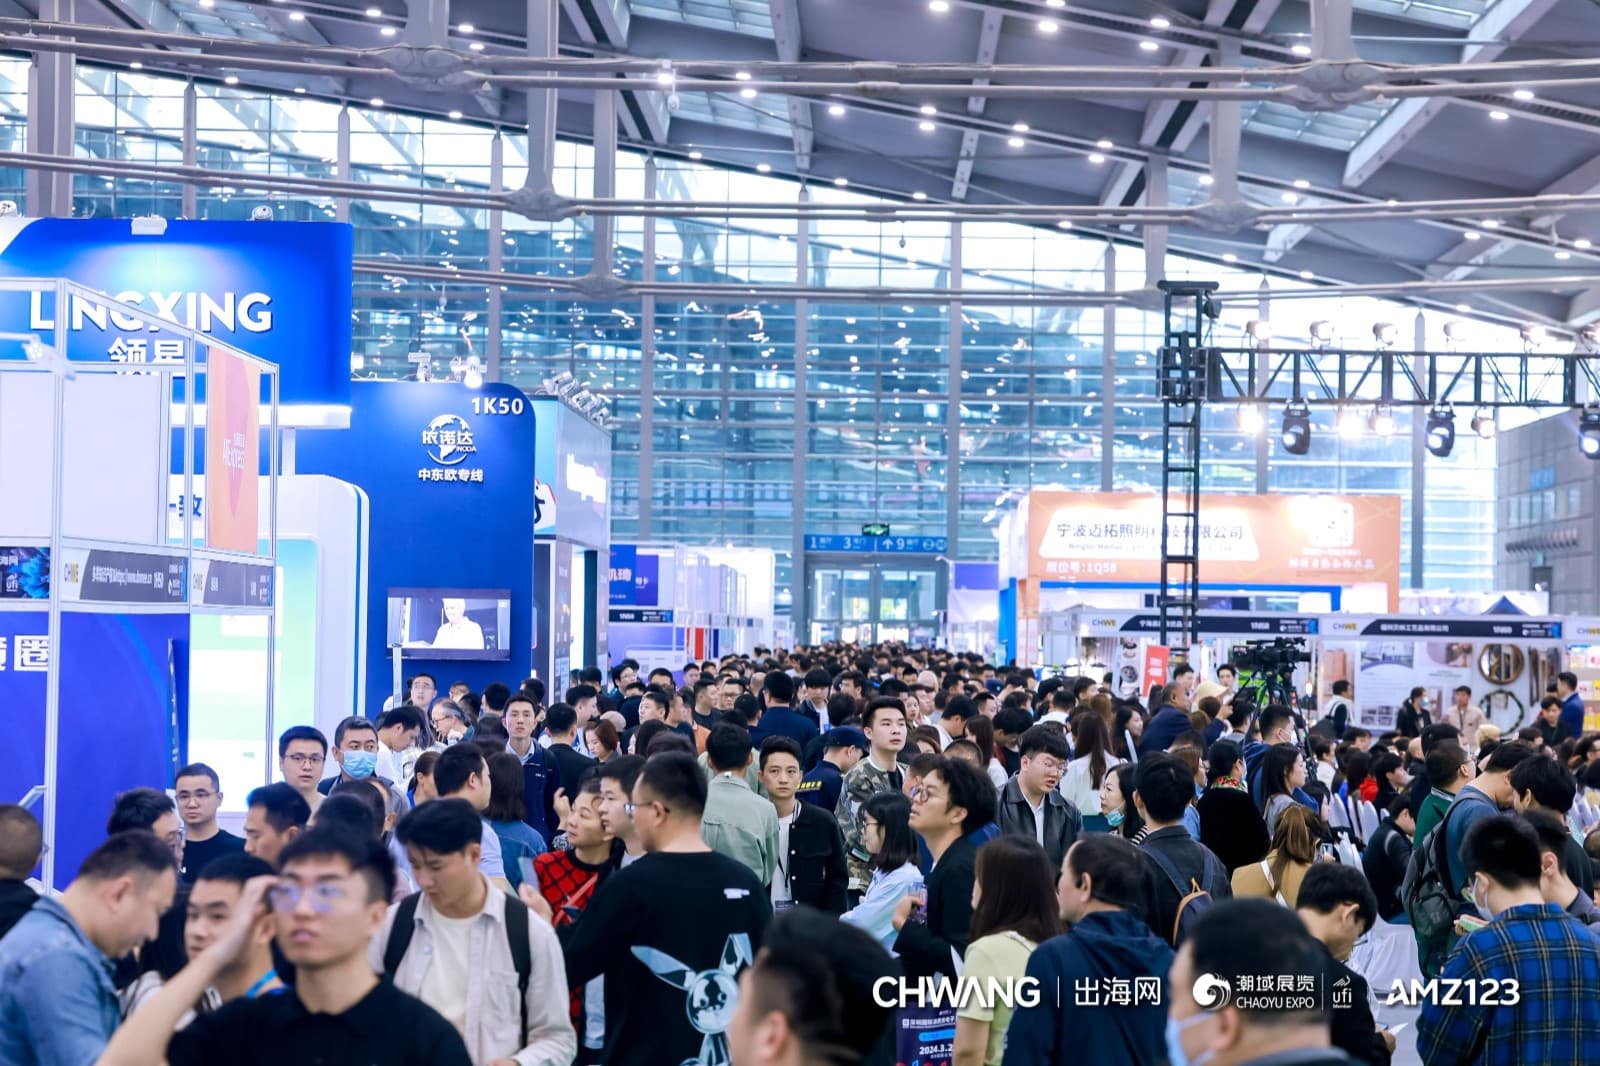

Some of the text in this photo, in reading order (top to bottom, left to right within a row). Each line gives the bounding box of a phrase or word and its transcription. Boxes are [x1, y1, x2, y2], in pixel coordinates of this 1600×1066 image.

[30, 291, 272, 332] LNGXING
[472, 397, 524, 415] 1K50
[418, 468, 484, 482] 中东欧专线
[843, 537, 851, 549] 3
[896, 538, 905, 550] 9
[0, 634, 49, 672] 圈
